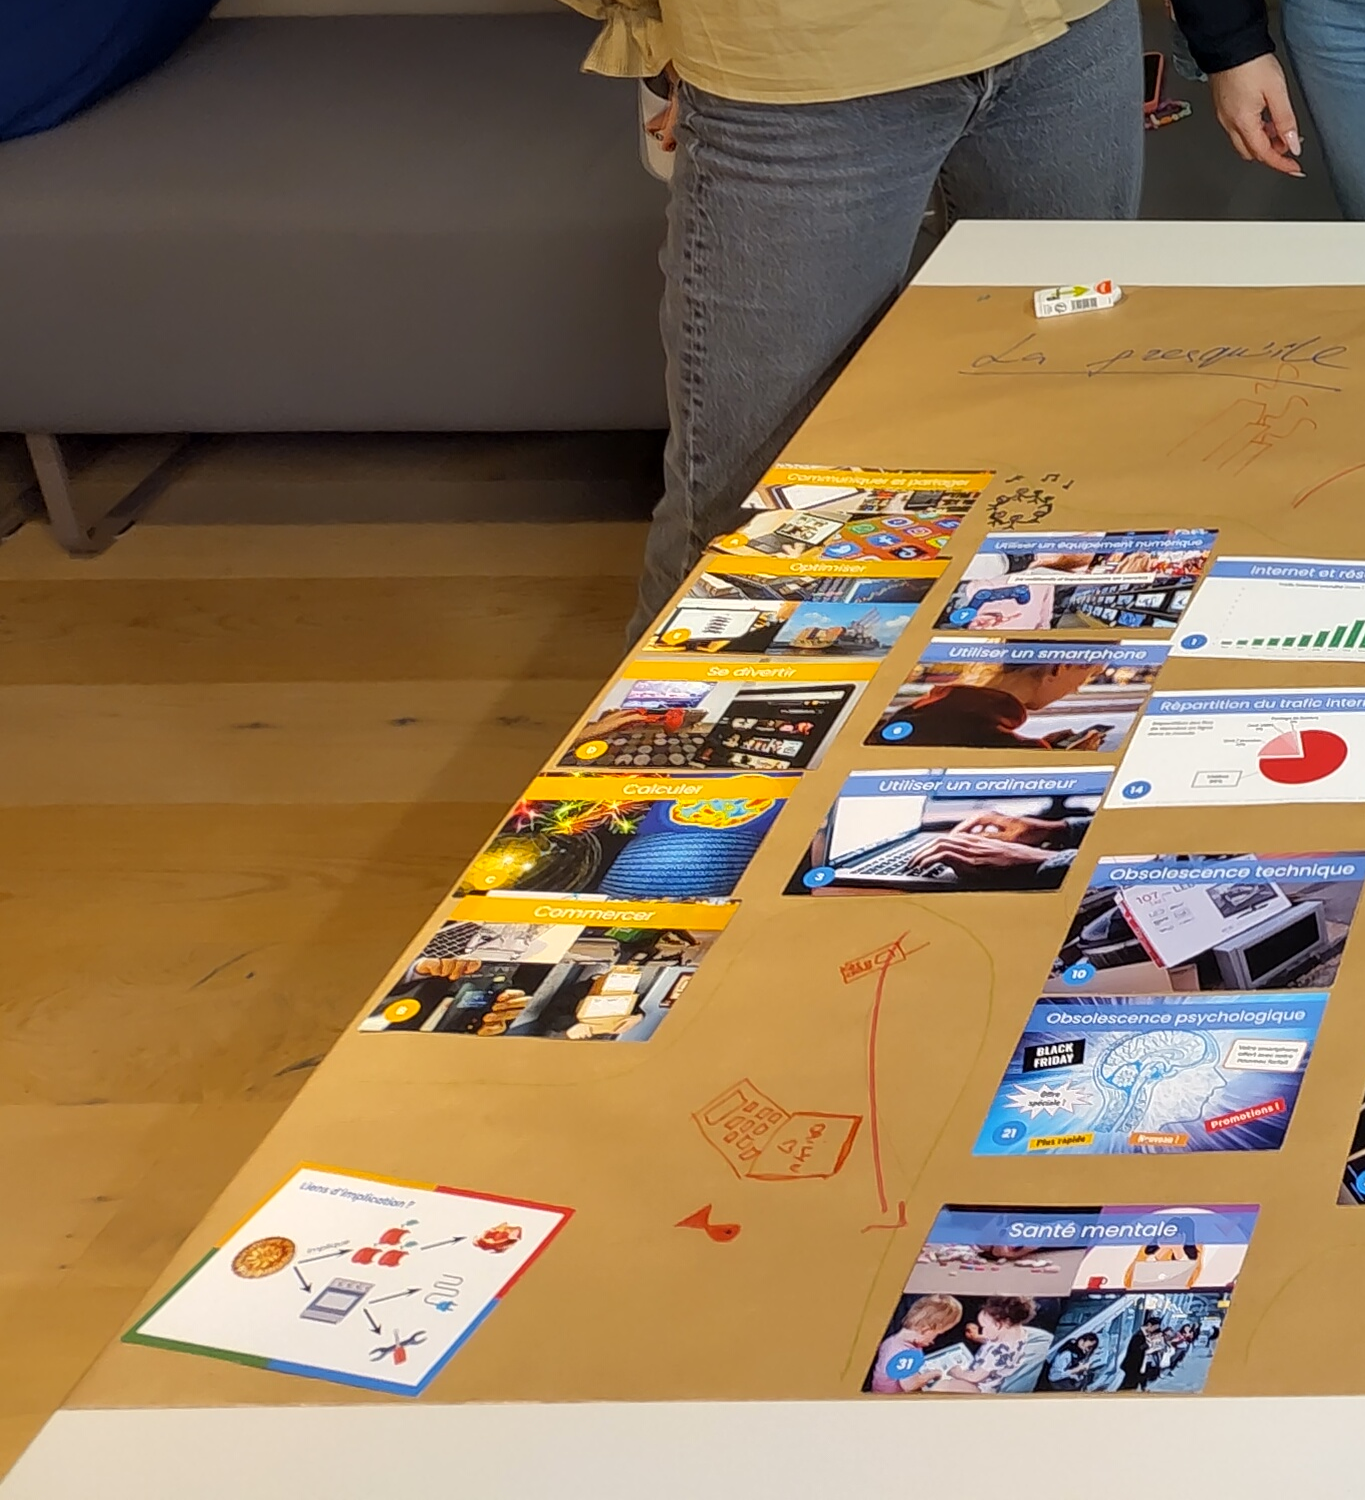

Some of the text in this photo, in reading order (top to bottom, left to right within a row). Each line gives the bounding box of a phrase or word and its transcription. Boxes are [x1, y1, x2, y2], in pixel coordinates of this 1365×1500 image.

[787, 471, 970, 488] Communiquer et partager
[994, 536, 1203, 551] Utiliser un équipement numérique
[789, 561, 868, 575] Optimiser
[1250, 564, 1315, 578] Internet
[1318, 567, 1337, 579] et
[949, 646, 1148, 662] Utiliser un smartphone
[707, 665, 798, 678] Se divertir
[1160, 698, 1251, 713] Répartition
[1253, 698, 1276, 710] du
[1279, 697, 1323, 710] trafic
[622, 782, 705, 796] Calculer
[879, 777, 1078, 792] Utiliser un ordinateur
[1128, 785, 1145, 795] 14
[1109, 863, 1356, 882] Obsolescence technique
[533, 904, 657, 922] Commercer
[1071, 969, 1087, 980] 10
[1046, 1008, 1307, 1028] Obsolescence psychologique
[1035, 1042, 1074, 1058] BLACK
[1033, 1053, 1075, 1069] FRIDAY
[1040, 1089, 1061, 1099] Offre
[1028, 1098, 1060, 1108] spéciale
[1209, 1104, 1274, 1131] Promotions
[1001, 1128, 1018, 1139] 21
[1036, 1133, 1087, 1147] Plus rapide
[1136, 1134, 1173, 1145] Nouveau
[299, 1180, 330, 1195] Liens
[1008, 1217, 1179, 1242] Santé mentale
[893, 1355, 915, 1373] 31
